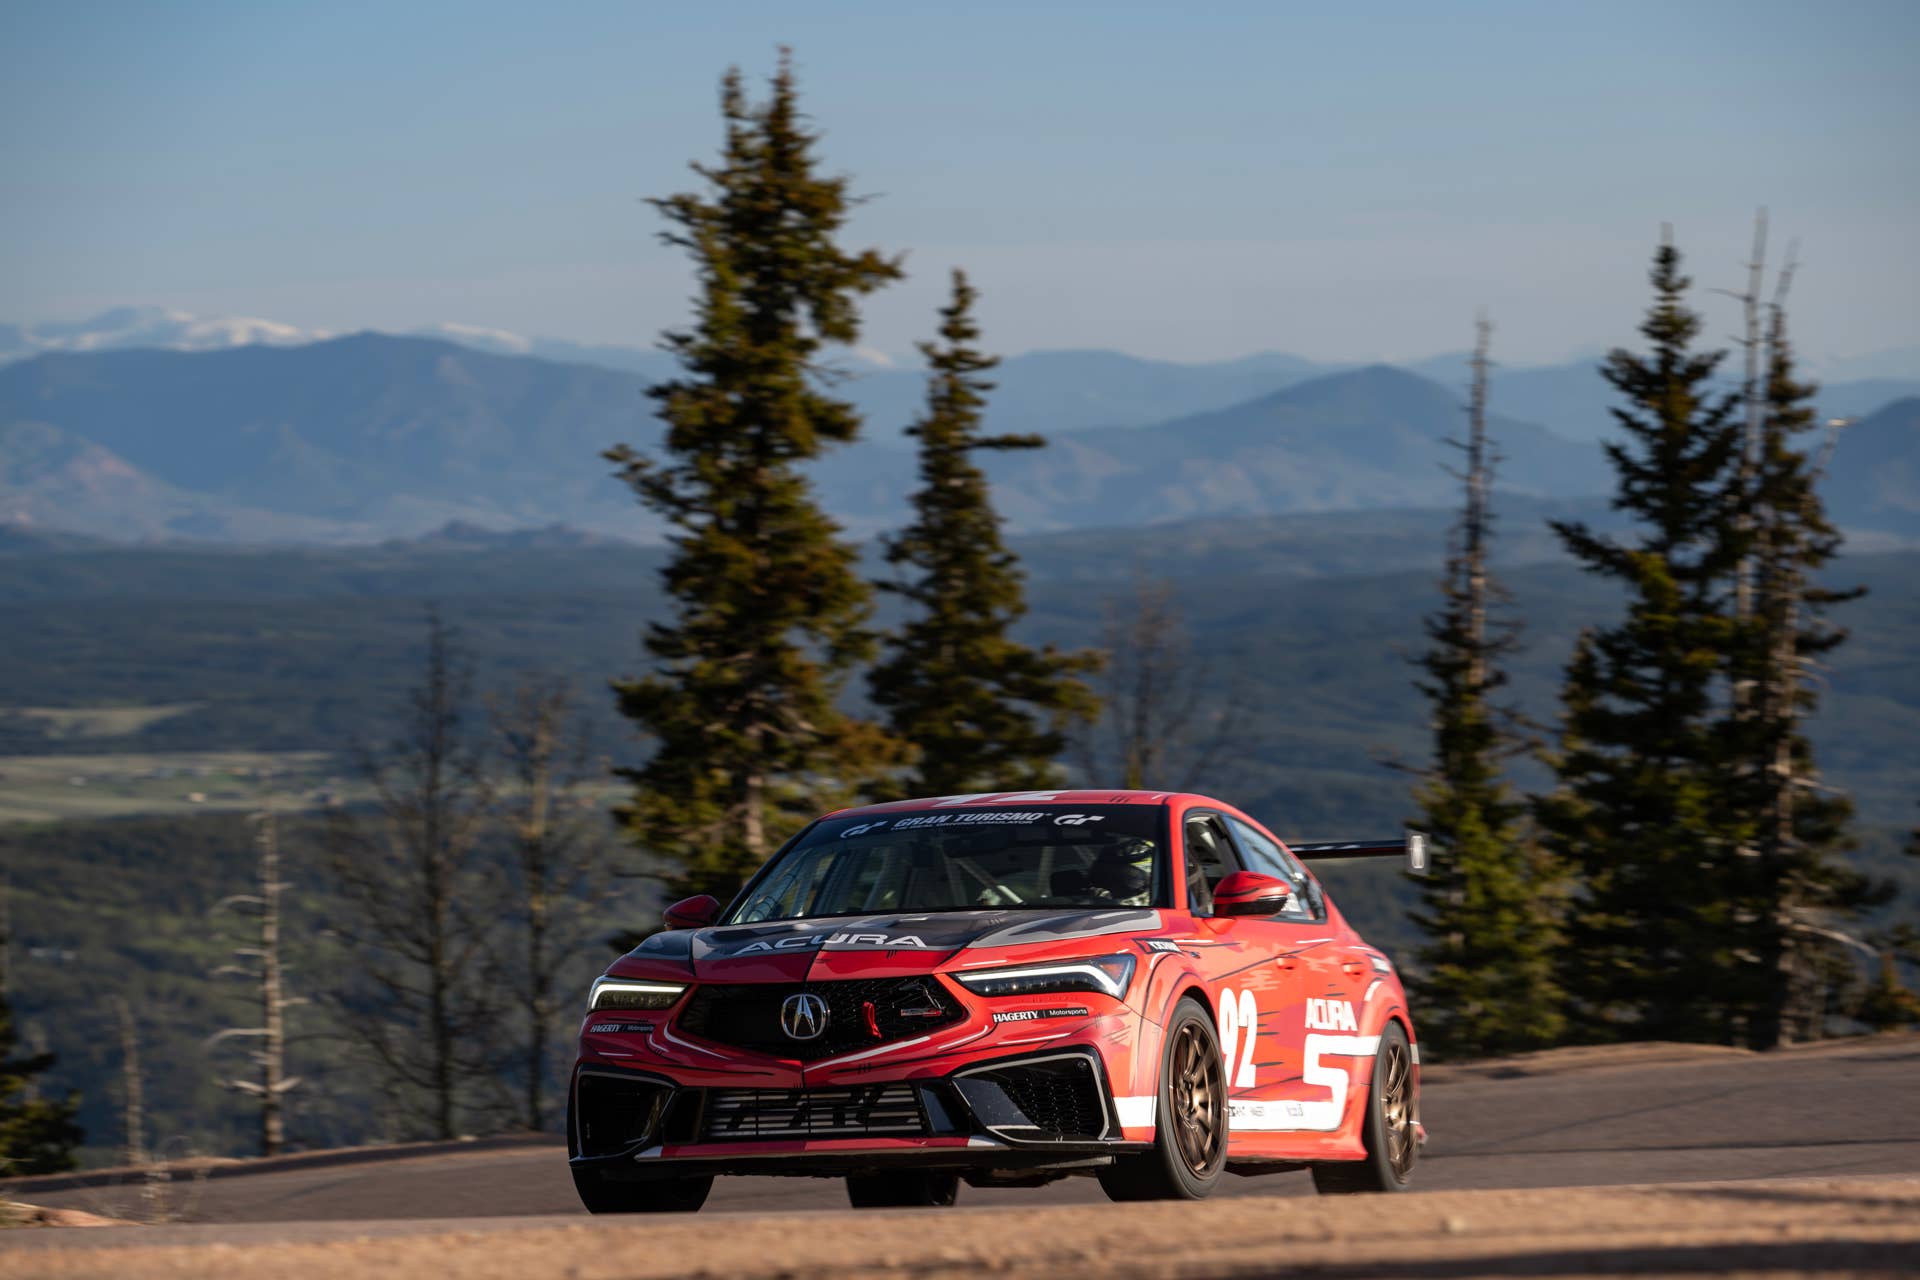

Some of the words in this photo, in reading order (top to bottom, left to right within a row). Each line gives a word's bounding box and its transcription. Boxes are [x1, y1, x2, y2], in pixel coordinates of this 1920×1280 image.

[893, 815, 953, 828] GRAN
[954, 812, 1045, 822] TURISMO
[730, 933, 928, 957] ACURA
[992, 1010, 1038, 1023] HAGERTY
[1048, 1008, 1088, 1017] Motorsports
[1304, 998, 1359, 1032] ACURA
[1219, 987, 1257, 1088] 92
